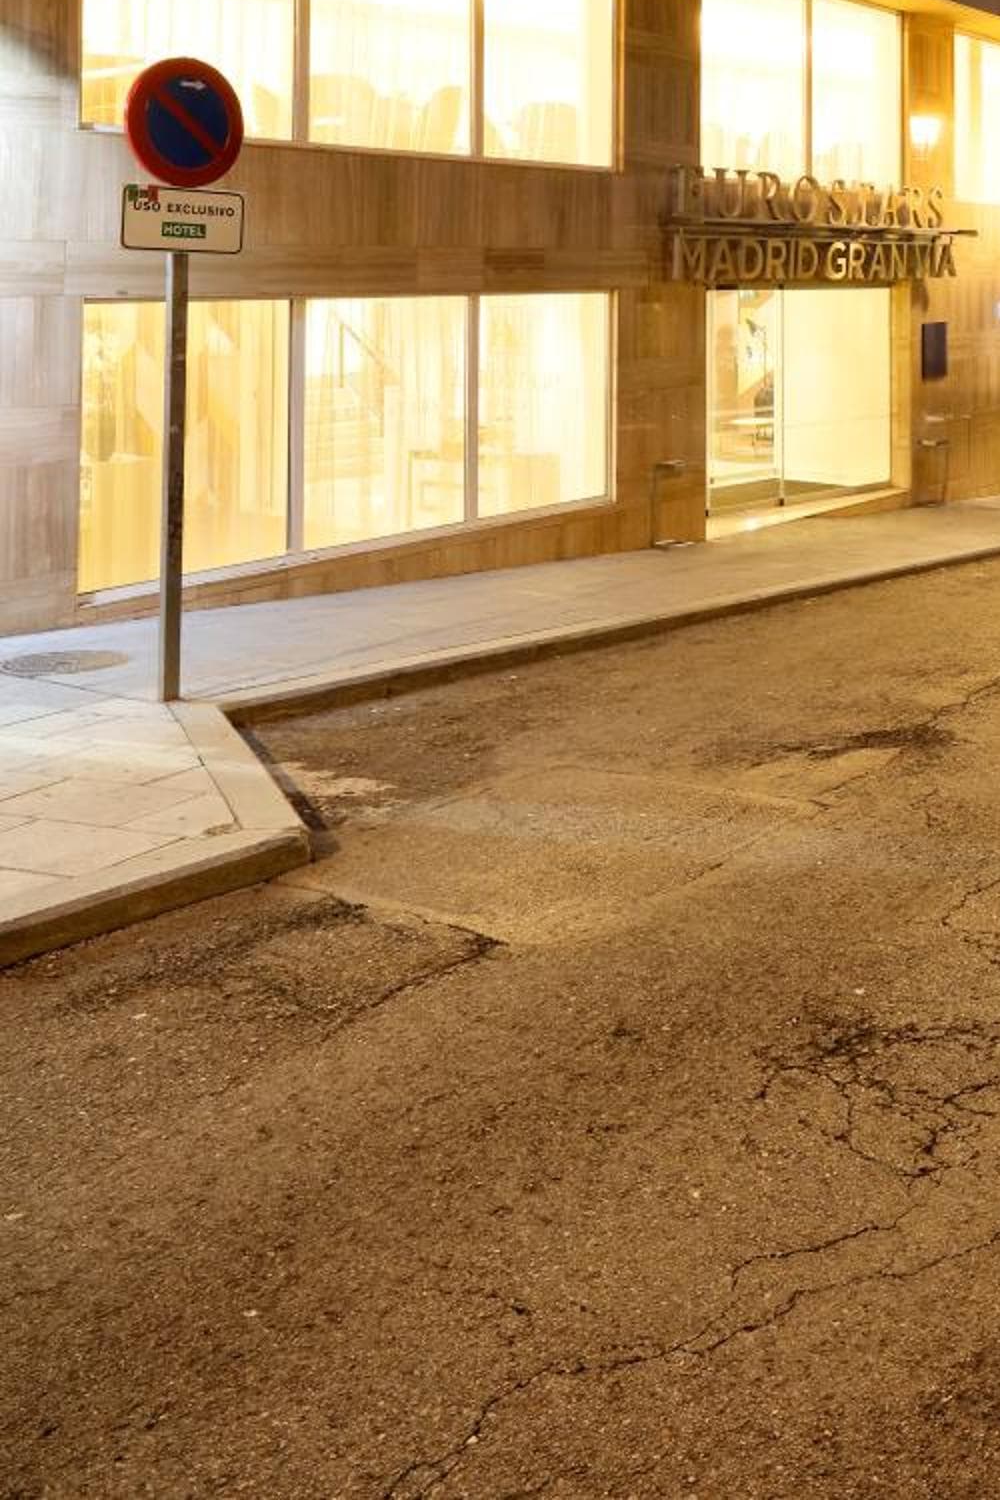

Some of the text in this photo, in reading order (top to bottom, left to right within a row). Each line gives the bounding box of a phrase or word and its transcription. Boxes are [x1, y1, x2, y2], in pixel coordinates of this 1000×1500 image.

[133, 200, 235, 217] USO EXCLUSIVO
[672, 164, 943, 227] EUROSTARS
[163, 224, 204, 236] HOTEL
[672, 232, 818, 280] MADRID
[827, 240, 908, 280] GRAN
